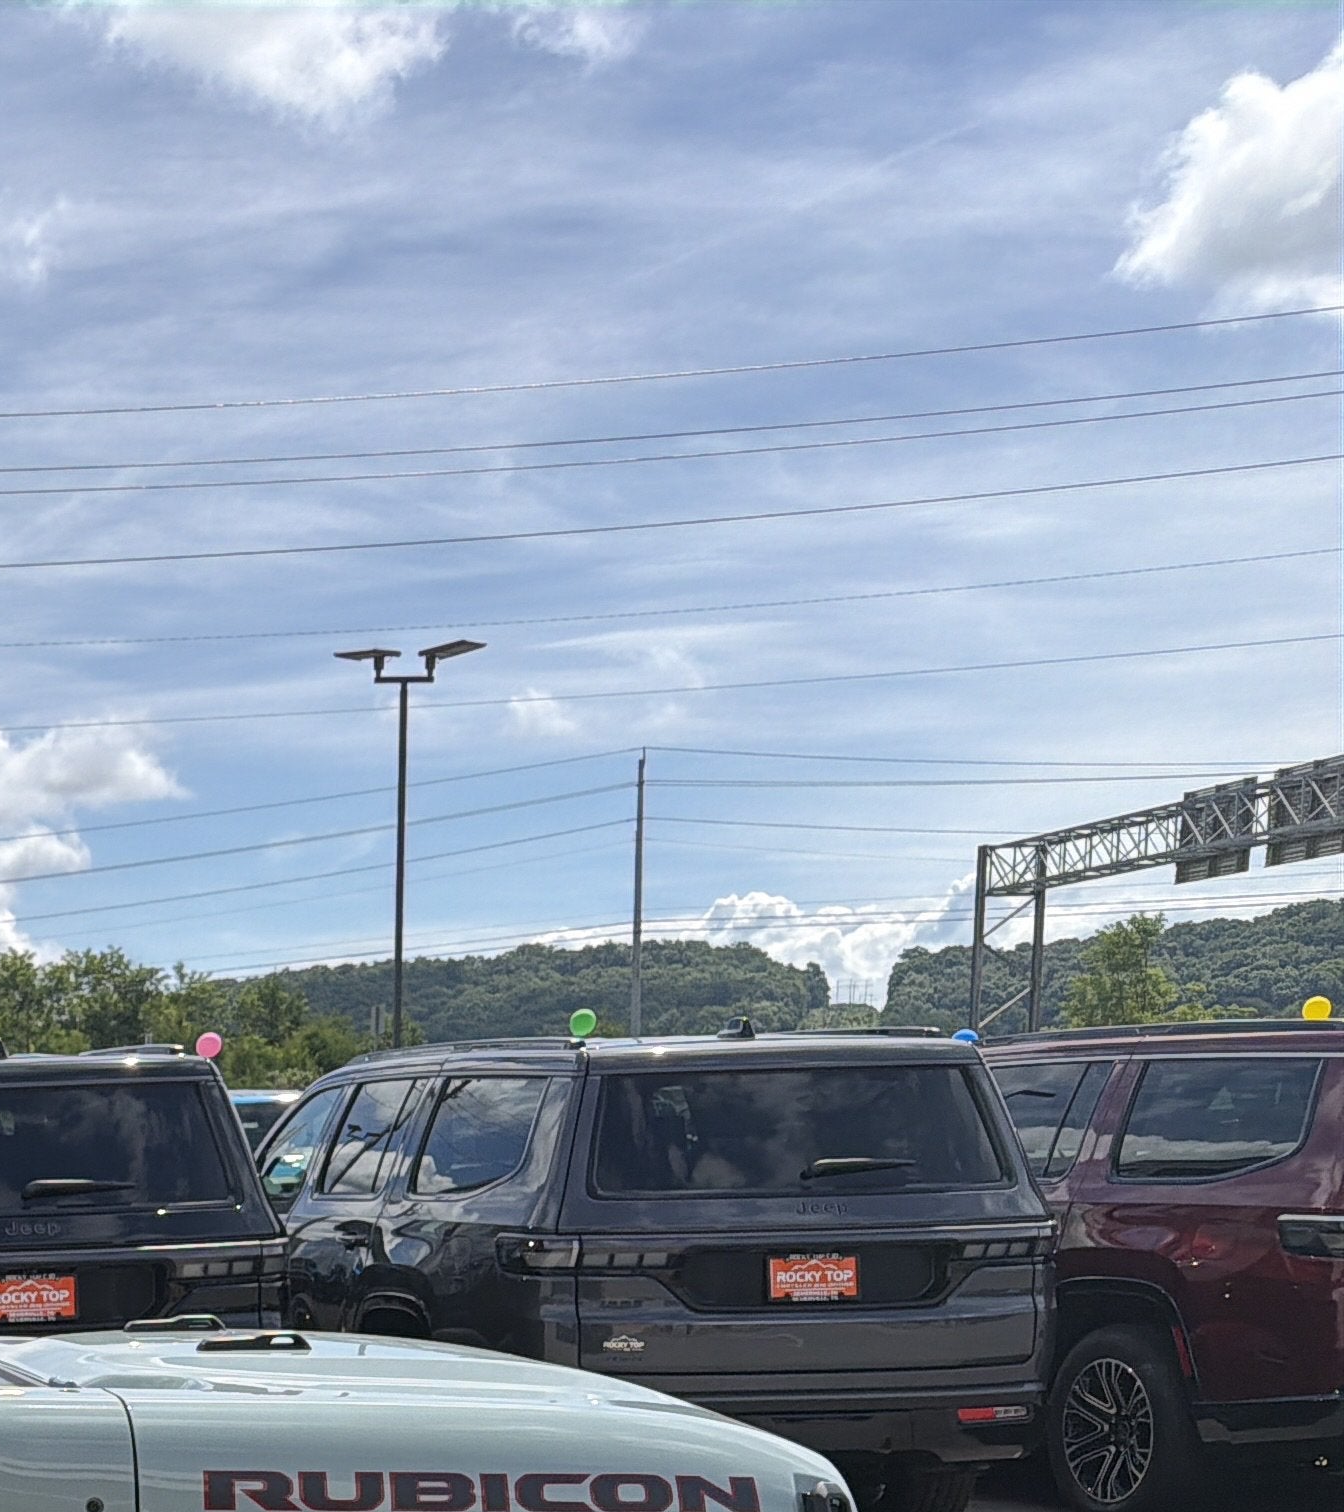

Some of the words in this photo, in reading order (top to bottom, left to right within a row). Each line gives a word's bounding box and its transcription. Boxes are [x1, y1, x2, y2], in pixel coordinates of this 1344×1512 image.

[796, 1201, 849, 1216] Jeep
[4, 1221, 62, 1237] Jeep
[776, 1271, 823, 1283] ROCKY
[824, 1270, 853, 1281] TOP
[40, 1290, 70, 1302] TOP
